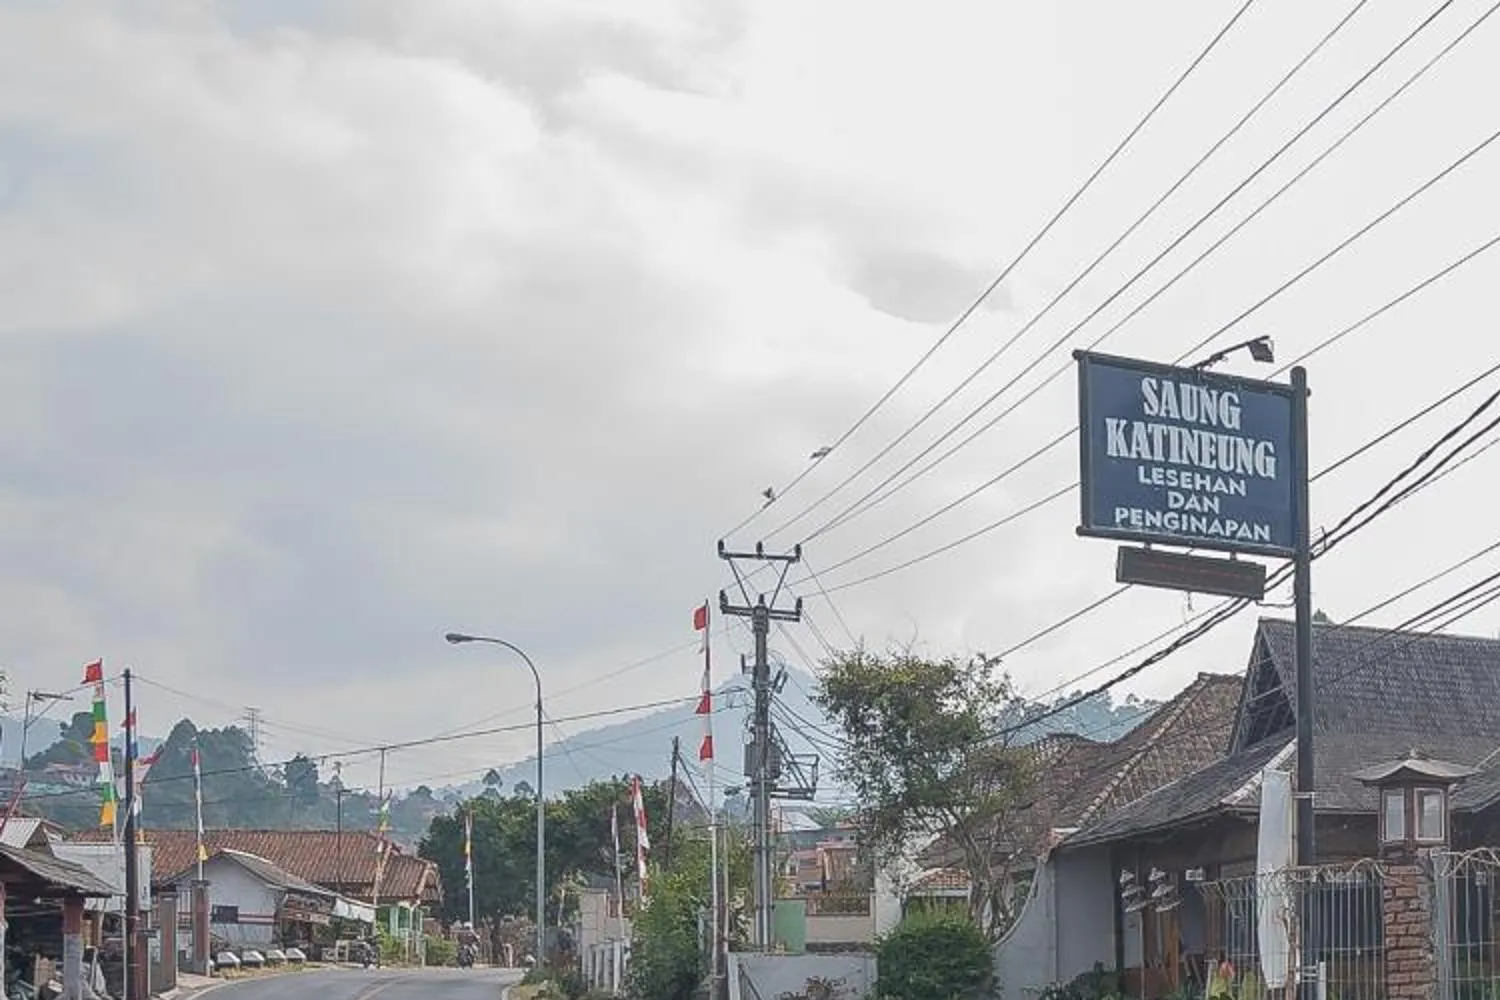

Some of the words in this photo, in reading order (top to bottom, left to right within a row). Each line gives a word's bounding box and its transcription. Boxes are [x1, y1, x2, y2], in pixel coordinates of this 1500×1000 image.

[1141, 376, 1241, 430] SAUNG
[1105, 417, 1276, 480] KATINEUNG
[1138, 465, 1247, 497] LESEHAN
[1167, 490, 1220, 514] DAN
[1115, 507, 1271, 541] PENGINAPAN
